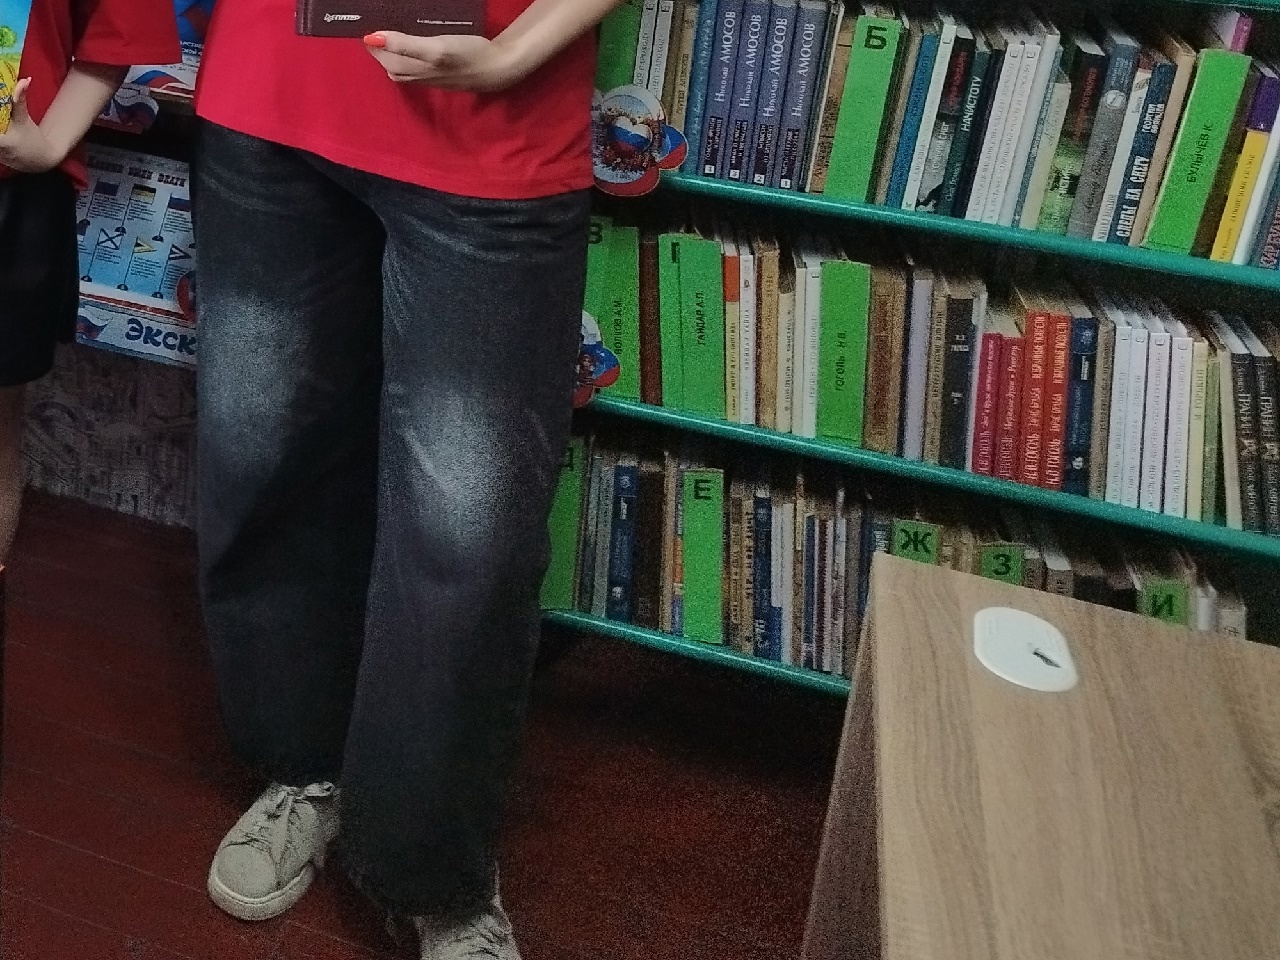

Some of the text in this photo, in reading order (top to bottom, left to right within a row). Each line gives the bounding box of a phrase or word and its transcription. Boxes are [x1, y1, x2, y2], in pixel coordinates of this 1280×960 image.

[720, 10, 736, 63] АМОСОВ
[745, 14, 762, 67] АМОСОВ
[770, 18, 788, 75] АМОСОВ
[797, 23, 815, 76] АМОСОВ
[864, 25, 888, 50] Б
[960, 76, 982, 132] НАЧИСТОТУ
[1116, 156, 1150, 237] СЛЕДЫ НА СНЕГУ
[694, 479, 711, 500] Е
[900, 528, 932, 554] Ж
[1152, 593, 1175, 618] И
